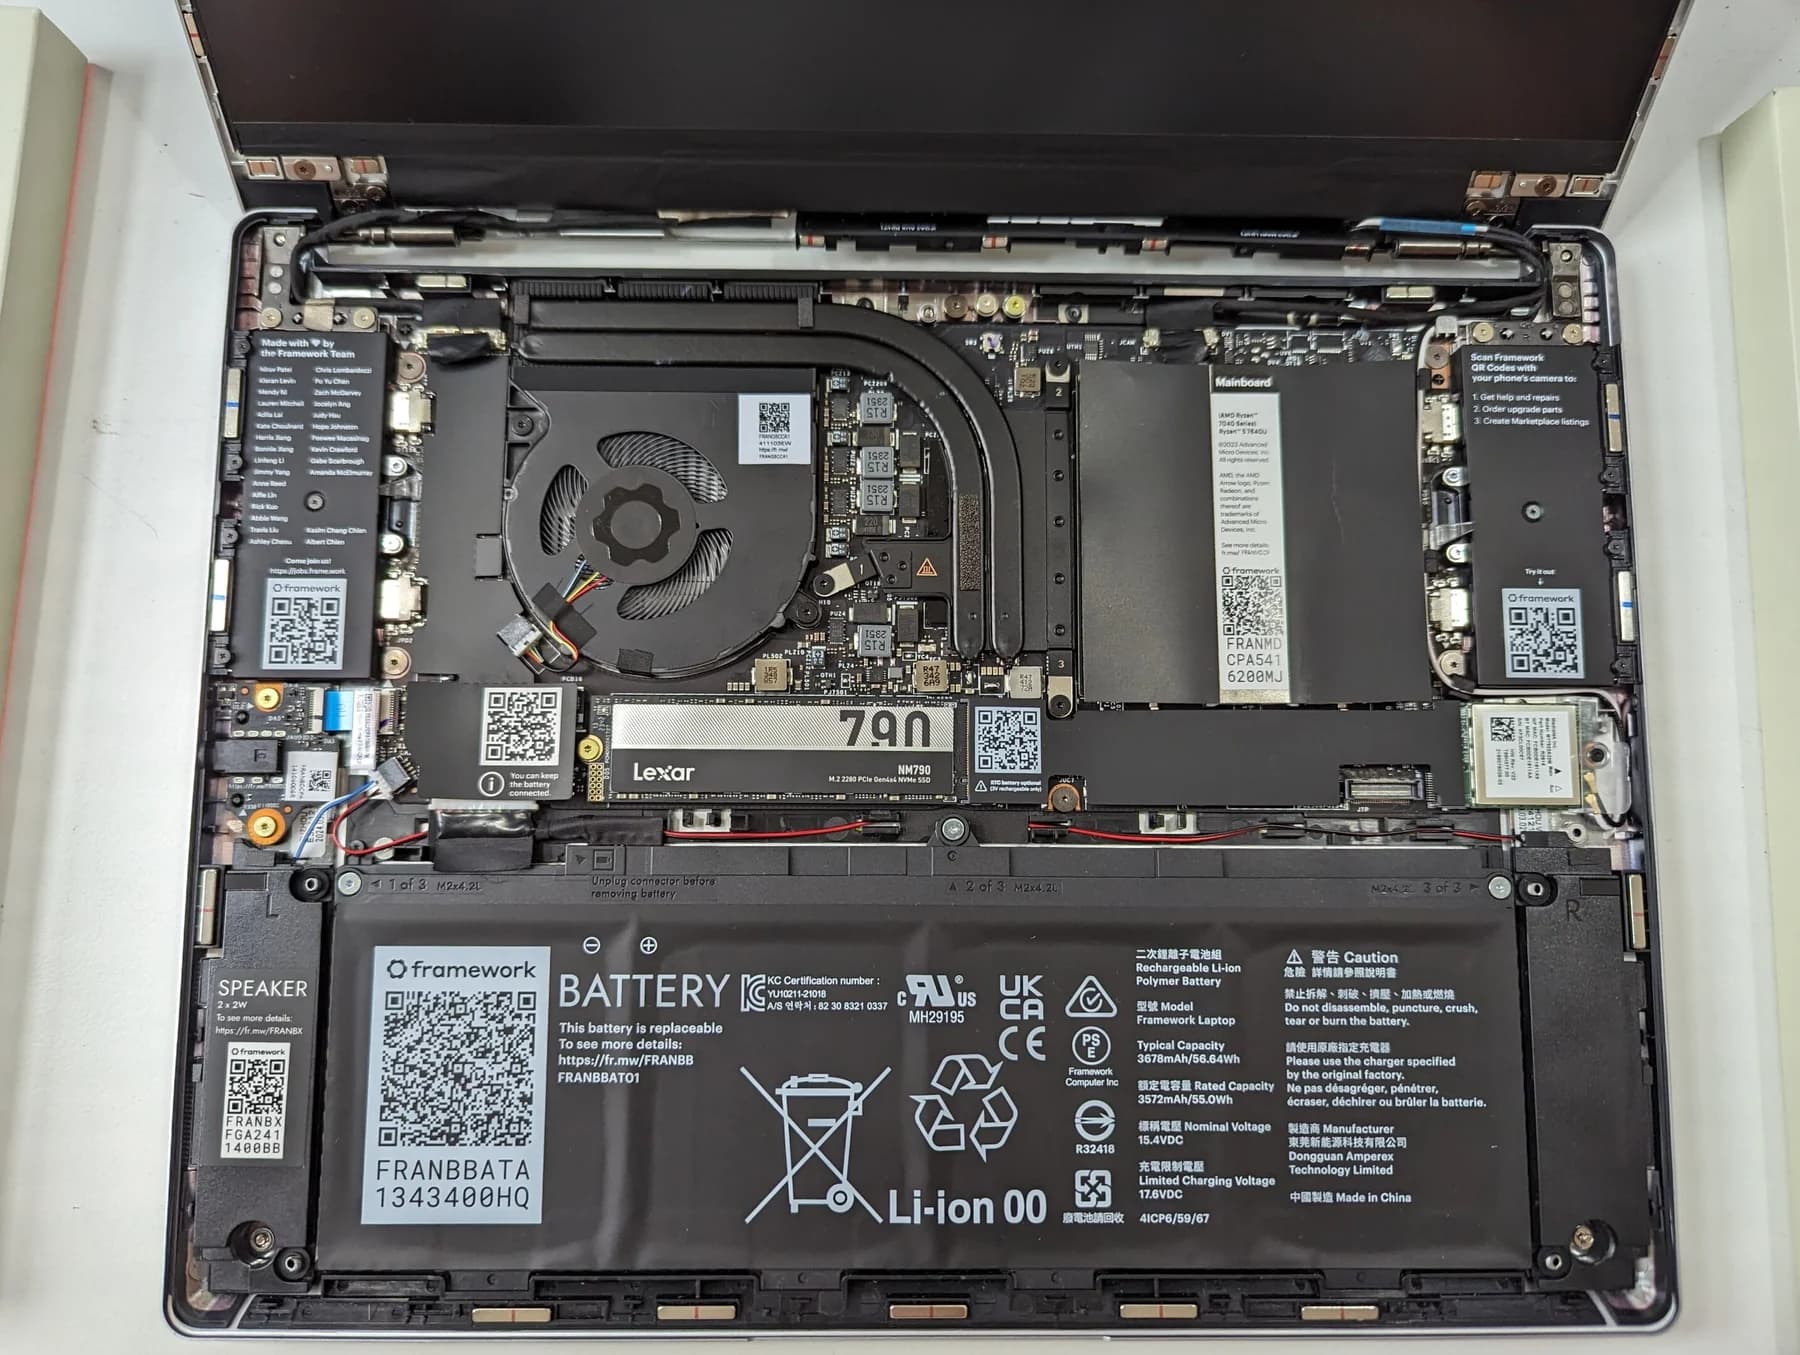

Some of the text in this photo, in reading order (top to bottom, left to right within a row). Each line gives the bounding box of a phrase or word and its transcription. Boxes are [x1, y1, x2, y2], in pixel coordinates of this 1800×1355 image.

[261, 339, 334, 349] Made with by
[278, 350, 329, 358] Framework
[1495, 354, 1544, 362] Framework
[1487, 364, 1515, 372] Codes
[1215, 376, 1272, 387] Mainboard
[1494, 375, 1528, 383] phone's
[1497, 394, 1513, 402] help
[1533, 394, 1560, 402] repairs
[1512, 418, 1560, 426] Marketplace
[1562, 419, 1589, 427] listings
[285, 584, 340, 592] framework
[1227, 638, 1281, 649] FRANMD
[1227, 654, 1281, 665] CPA541
[1228, 671, 1283, 682] 6200MJ
[633, 763, 695, 781] Lexar
[898, 765, 931, 775] NM790
[523, 781, 551, 789] battery
[592, 876, 715, 888] Unplug connector before
[591, 889, 676, 900] removing battery
[1566, 900, 1582, 922] R
[1312, 950, 1398, 964] 警告 Caution
[412, 961, 536, 978] framework
[1136, 963, 1241, 974] Rechargeable Li-ion
[768, 976, 873, 985] KC Certification number
[1000, 975, 1043, 996] UK
[1136, 976, 1221, 988] Polymer Battery
[218, 980, 308, 997] SPEAKER
[559, 973, 731, 1007] BATTERY
[1000, 998, 1044, 1020] CA
[1136, 1000, 1193, 1012] 型號 Model
[1285, 1003, 1478, 1014] Do not disassemble, puncture, crush,
[909, 1010, 964, 1023] MH29195
[1136, 1015, 1235, 1026] Framework Laptop
[1285, 1016, 1410, 1027] tear or burn the battery.
[215, 1027, 303, 1036] https://fr.mw/FRANBX
[559, 1022, 723, 1035] This battery is replaceable
[559, 1039, 682, 1050] To see more details:
[1137, 1040, 1224, 1052] Typical Capacity
[558, 1054, 694, 1067] https://fr.mw/FRANBB
[1137, 1054, 1240, 1064] 3678mAh/56.64Wh
[1286, 1057, 1456, 1068] Please use the charger specified
[558, 1072, 640, 1083] FRANBBAT01
[1286, 1070, 1405, 1082] by the original factory.
[1066, 1078, 1104, 1088] Computer
[1194, 1081, 1226, 1091] Rated
[1228, 1082, 1274, 1092] Capacity
[1287, 1084, 1439, 1095] Ne pas désagréger, pénétrer,
[1138, 1094, 1233, 1105] 3572mAh/55.0Wh
[1287, 1097, 1486, 1108] écraser, déchirer ou brûler la batterie.
[226, 1116, 282, 1127] FRANBX
[1184, 1122, 1228, 1131] Nominal
[1232, 1122, 1271, 1133] Voltage
[1323, 1124, 1394, 1134] Manufacturer
[226, 1129, 280, 1140] FGA241
[1138, 1136, 1184, 1144] 15.4VDC
[225, 1143, 280, 1153] 1400BB
[1076, 1144, 1115, 1154] R32418
[1289, 1152, 1394, 1163] Dongguan Amperex
[377, 1160, 530, 1180] FRANBBATA
[1289, 1165, 1393, 1176] Technology Limited
[1139, 1176, 1275, 1188] Limited Charging Voltage
[376, 1187, 529, 1209] 1343400HQ
[1138, 1190, 1183, 1199] 17.6VDC
[1336, 1193, 1365, 1202] Made
[1368, 1193, 1378, 1202] in
[1381, 1193, 1411, 1202] China
[889, 1189, 1047, 1224] Li-ion 00
[1140, 1214, 1210, 1224] 4ICP6/59/67
